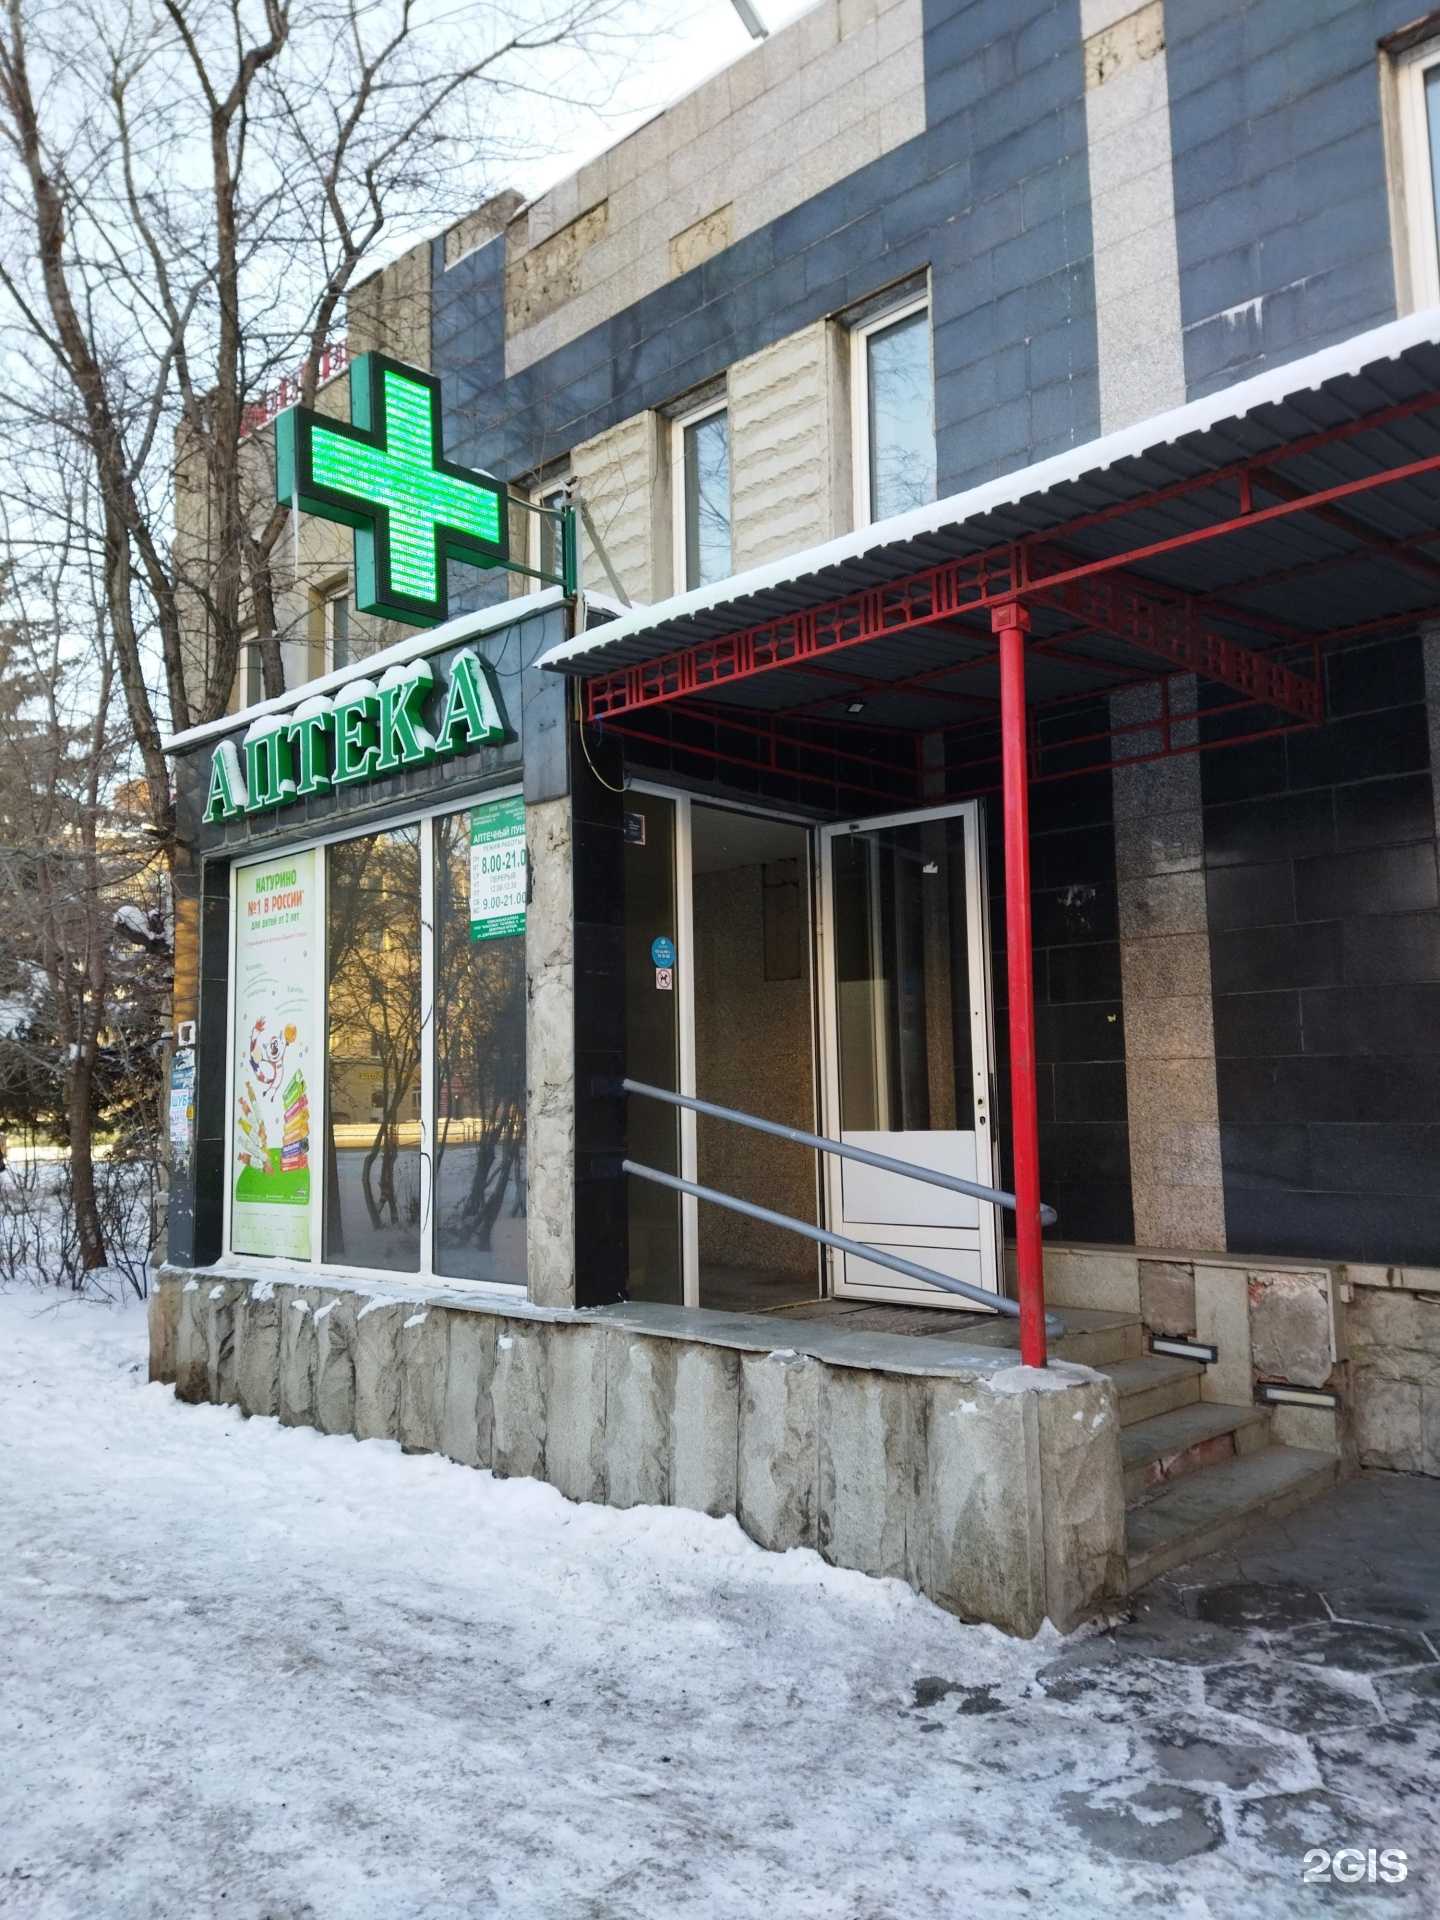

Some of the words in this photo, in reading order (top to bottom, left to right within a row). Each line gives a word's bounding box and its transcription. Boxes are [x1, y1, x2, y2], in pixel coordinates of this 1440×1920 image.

[202, 652, 500, 824] АПТЕКА
[473, 826, 510, 844] АПТЕЧНЫЙ
[256, 870, 297, 893] НАТУРИНО
